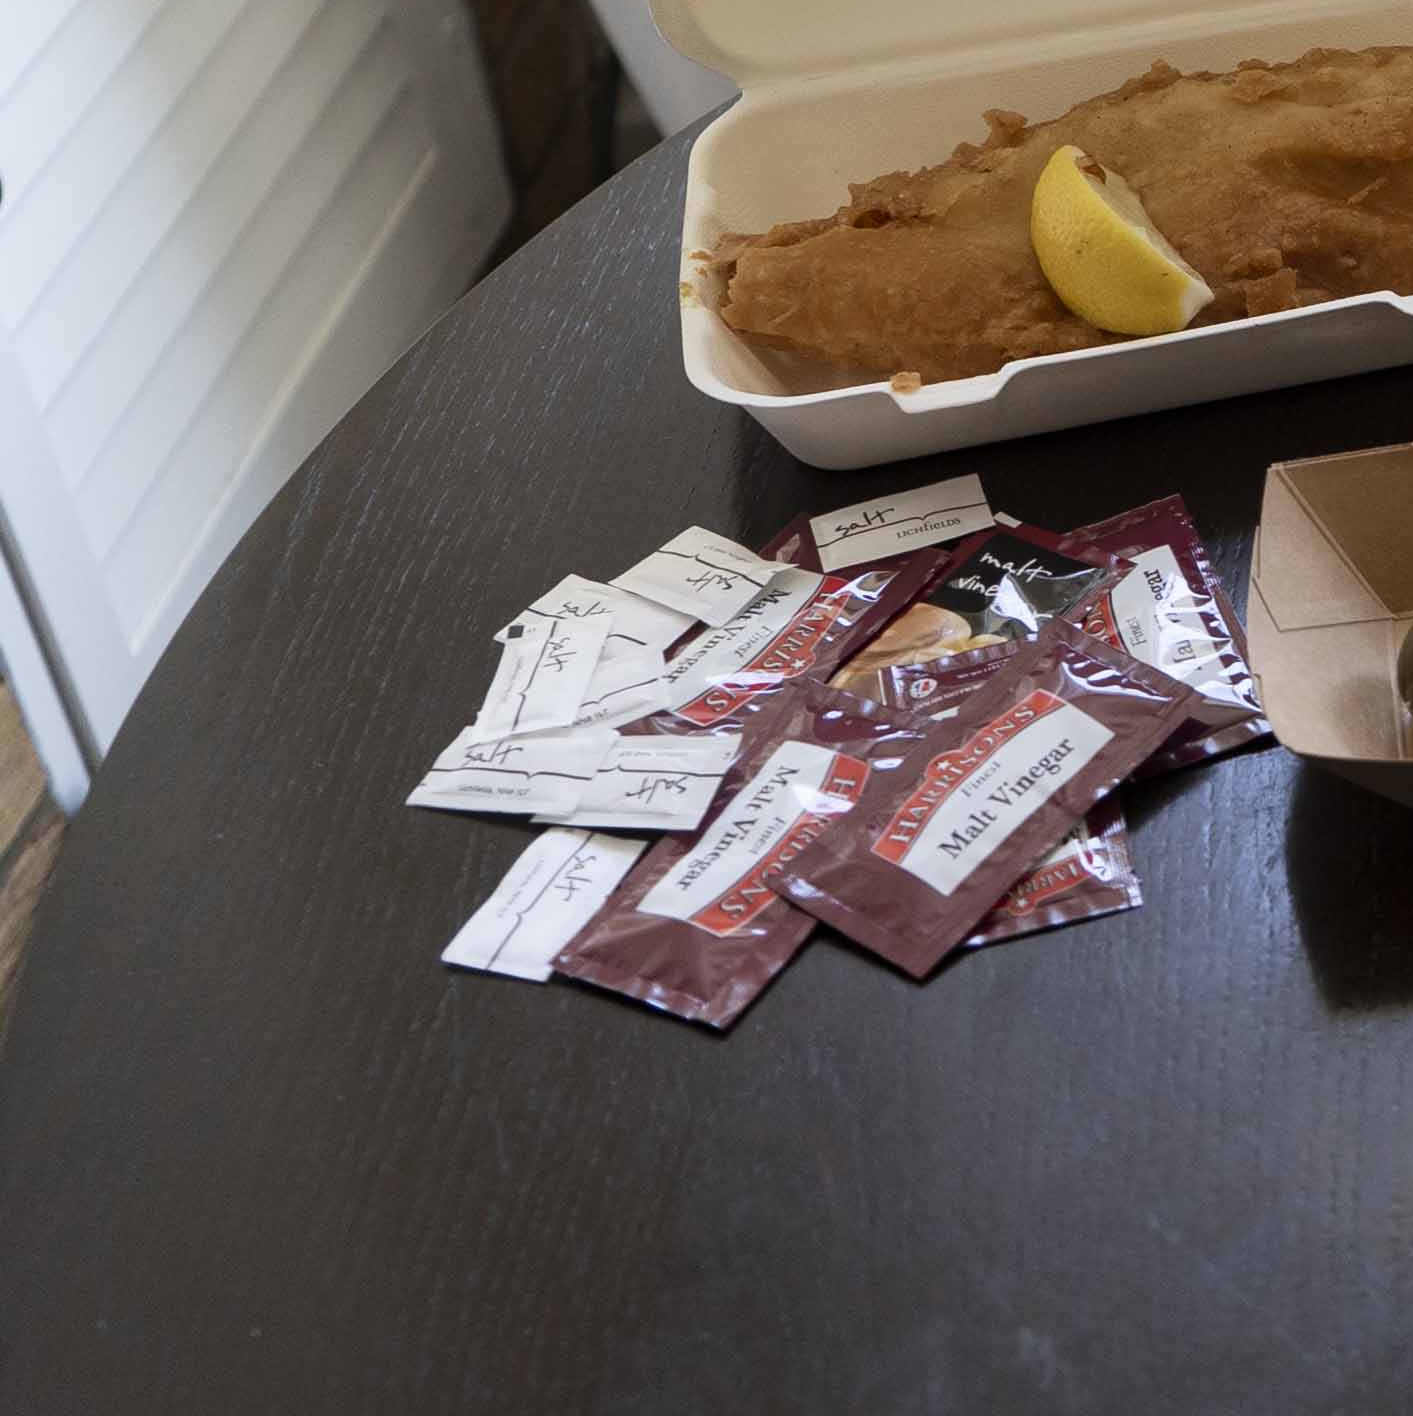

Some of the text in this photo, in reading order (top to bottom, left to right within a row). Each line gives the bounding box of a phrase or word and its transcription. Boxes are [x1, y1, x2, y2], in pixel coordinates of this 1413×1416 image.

[834, 507, 895, 535] salt
[685, 571, 738, 592] salt
[979, 550, 1052, 582] malt
[561, 600, 615, 617] salt
[661, 587, 791, 684] Malt Vinegar
[544, 637, 576, 674] salt
[463, 741, 523, 767] salt
[626, 775, 688, 803] salt
[890, 706, 1035, 844] HARRISONS
[961, 760, 1001, 798] Finest
[937, 736, 1076, 860] Malt Vinegar
[676, 765, 800, 891] Malt Vinegar
[751, 816, 786, 856] Finest
[554, 855, 597, 902] salt
